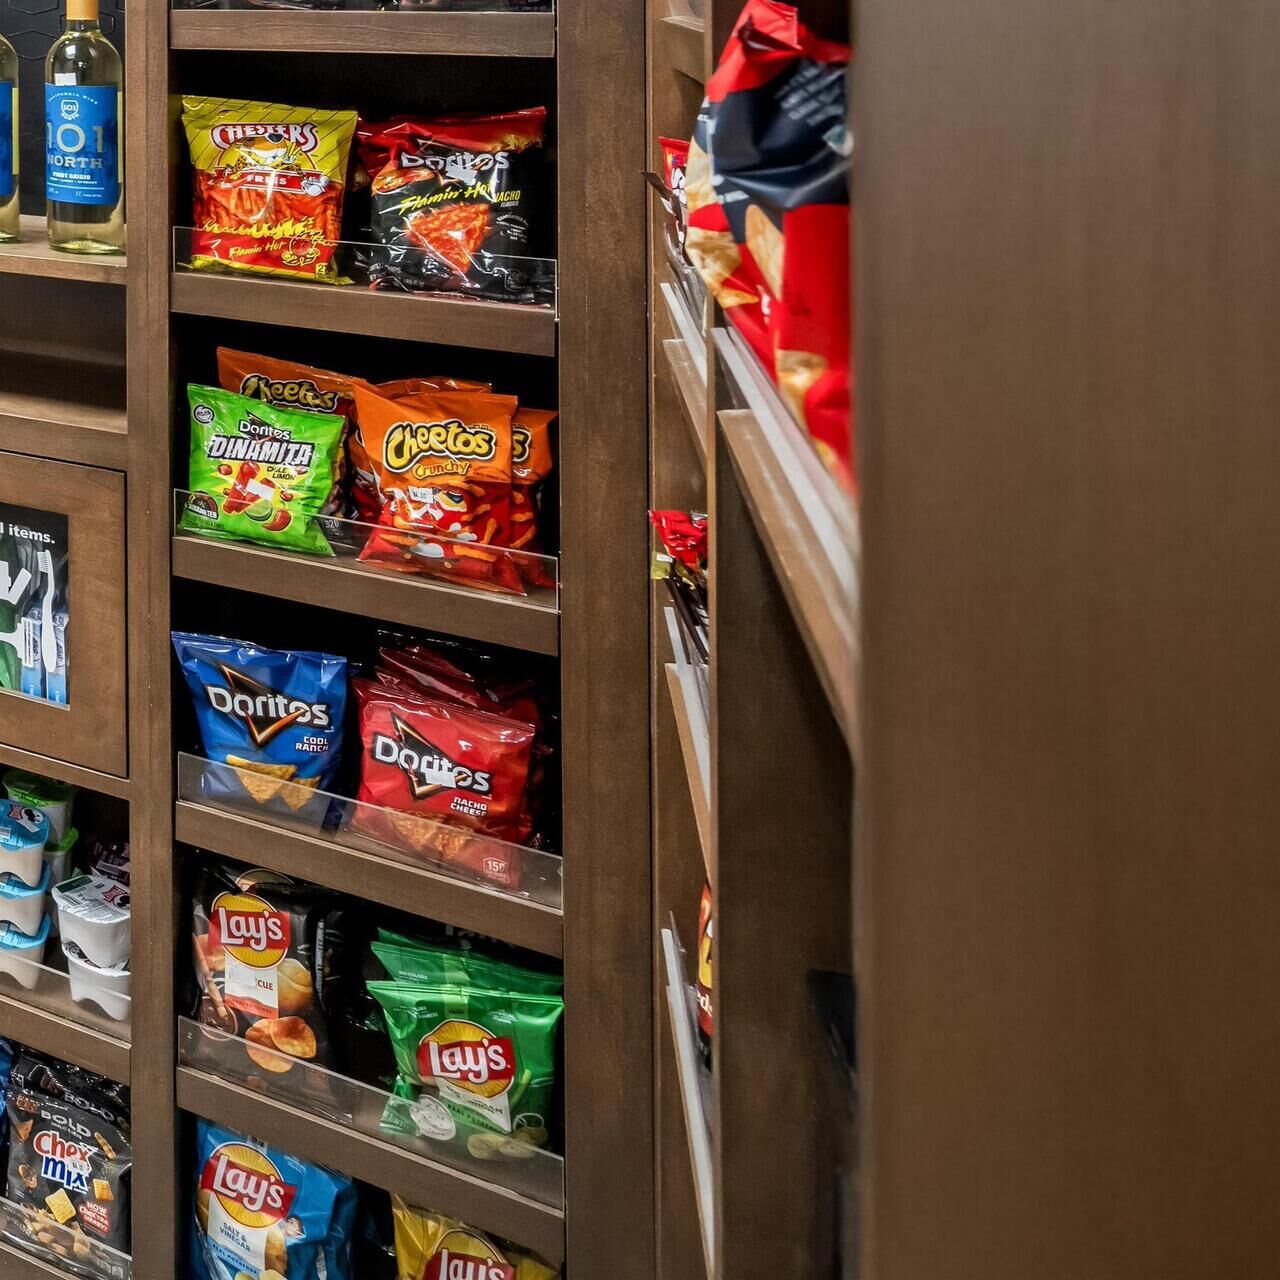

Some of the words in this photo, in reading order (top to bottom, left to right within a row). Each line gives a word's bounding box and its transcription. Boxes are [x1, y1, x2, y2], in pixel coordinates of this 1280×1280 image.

[46, 122, 104, 153] 101
[211, 122, 319, 153] CHESTER'S
[47, 155, 104, 169] NORTH
[398, 185, 463, 216] Flamin'
[265, 240, 284, 252] Hot
[239, 420, 290, 440] Doritos
[209, 436, 314, 466] DINAMITA
[385, 420, 493, 471] Cheetos
[412, 458, 471, 480] Crunchy
[8, 523, 56, 545] items.
[208, 686, 329, 728] Doritos
[295, 742, 329, 752] RANCH
[303, 735, 329, 745] COOL
[375, 735, 490, 792] Doritos
[450, 804, 487, 817] CHEESE
[454, 796, 487, 811] NACHO
[217, 906, 284, 951] Lay's
[429, 1037, 507, 1084] Lay's
[41, 1110, 92, 1138] BOLD
[34, 1130, 93, 1165] Chex
[42, 1155, 88, 1192] mix
[212, 1153, 285, 1212] Lay's
[219, 1227, 252, 1253] VINEGAR
[223, 1222, 241, 1238] SALT
